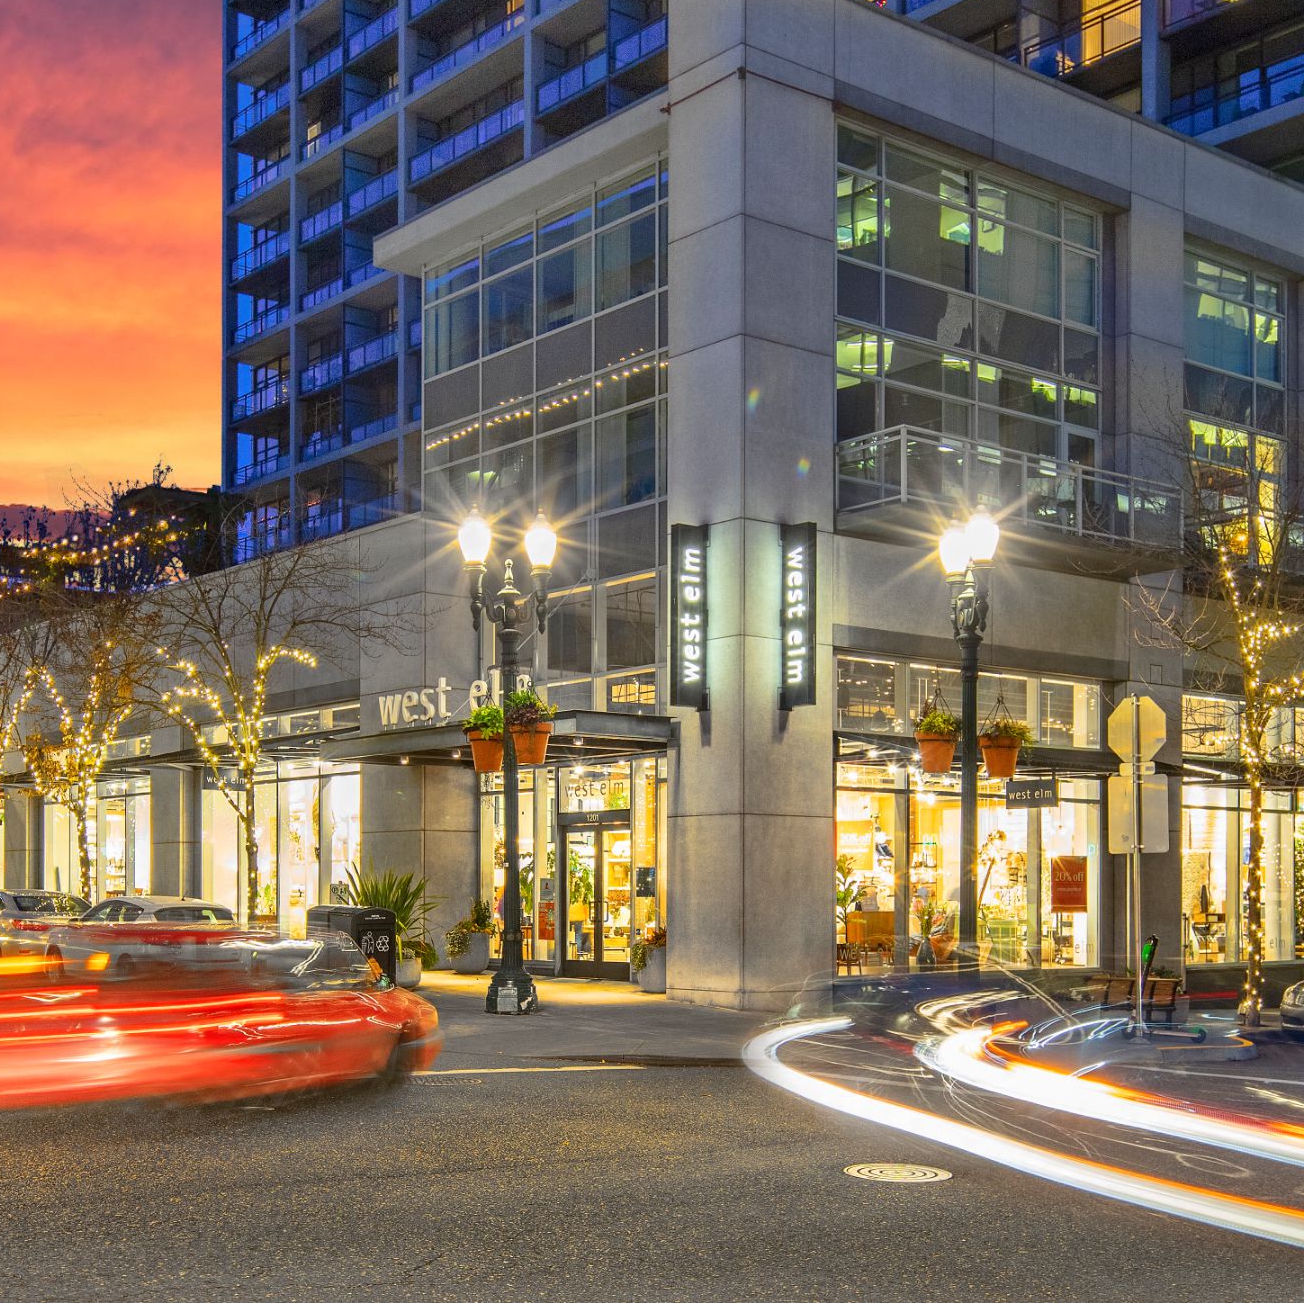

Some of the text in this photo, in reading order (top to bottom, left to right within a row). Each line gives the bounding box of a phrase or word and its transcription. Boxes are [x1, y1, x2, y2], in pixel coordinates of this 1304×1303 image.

[681, 547, 701, 683] west elm
[787, 546, 806, 684] west elm
[379, 677, 452, 725] west
[207, 776, 228, 784] wet
[600, 779, 624, 795] elm
[1009, 788, 1053, 800] west elm
[587, 814, 599, 822] 1201
[1054, 871, 1085, 882] 20% off
